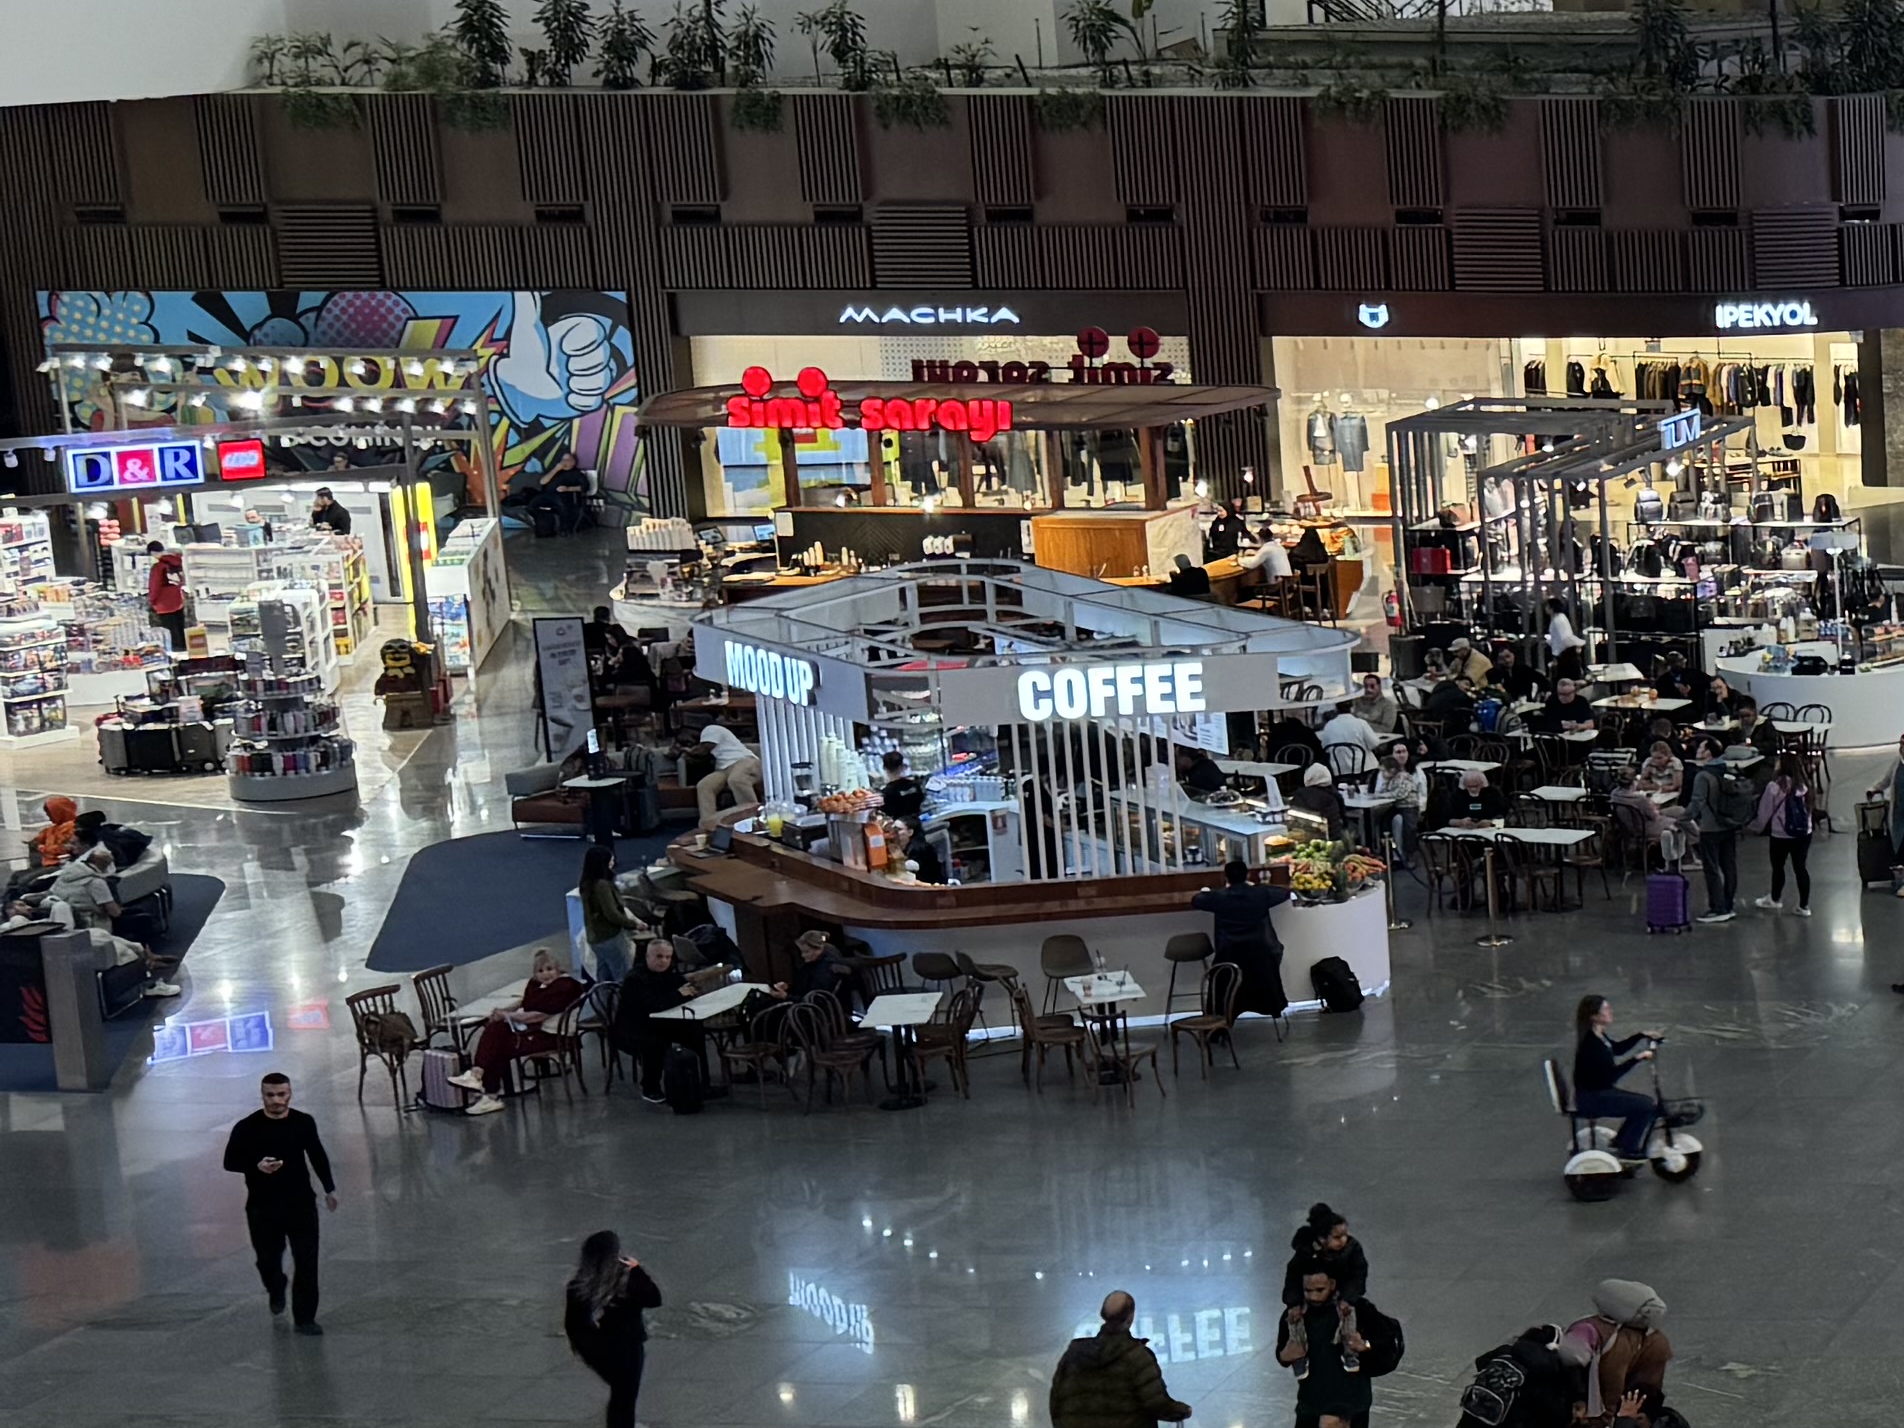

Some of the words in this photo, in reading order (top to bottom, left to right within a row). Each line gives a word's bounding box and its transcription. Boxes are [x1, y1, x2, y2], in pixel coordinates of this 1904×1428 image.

[840, 306, 1020, 324] MACHKA
[726, 365, 844, 429] simit
[860, 397, 1013, 443] sarayı
[76, 446, 197, 489] D&R
[1017, 662, 1207, 722] COFFEE
